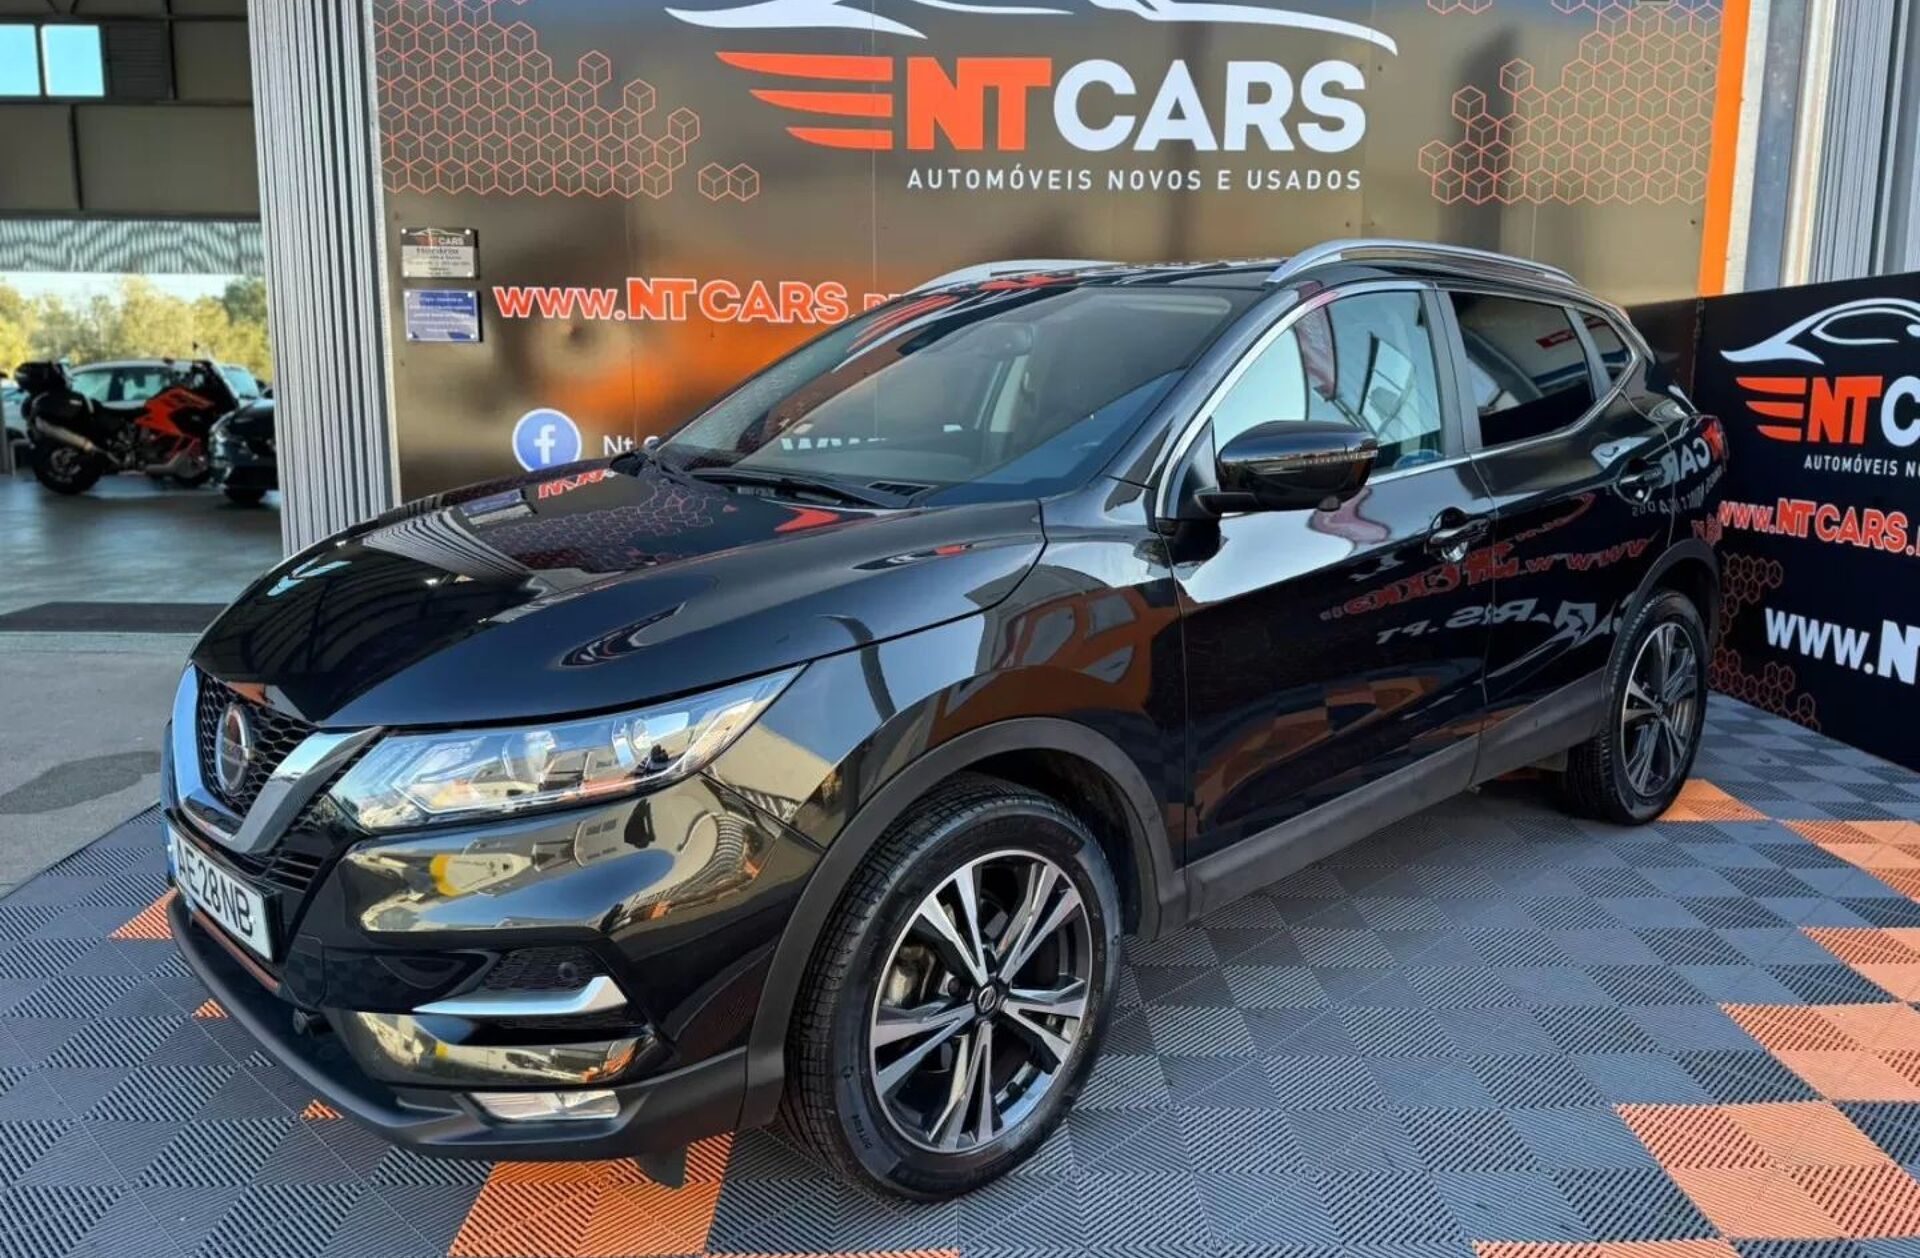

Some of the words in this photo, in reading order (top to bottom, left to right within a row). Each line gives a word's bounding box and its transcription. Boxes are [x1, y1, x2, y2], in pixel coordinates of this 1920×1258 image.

[907, 56, 1367, 151] NTCARS
[907, 163, 1093, 192] AUTOMÓVEIS
[1108, 168, 1201, 190] NOVOS
[1218, 169, 1230, 190] E
[1247, 169, 1362, 191] USADOS
[1804, 453, 1898, 476] AUTOMÓVEIS
[1905, 461, 1920, 478] N
